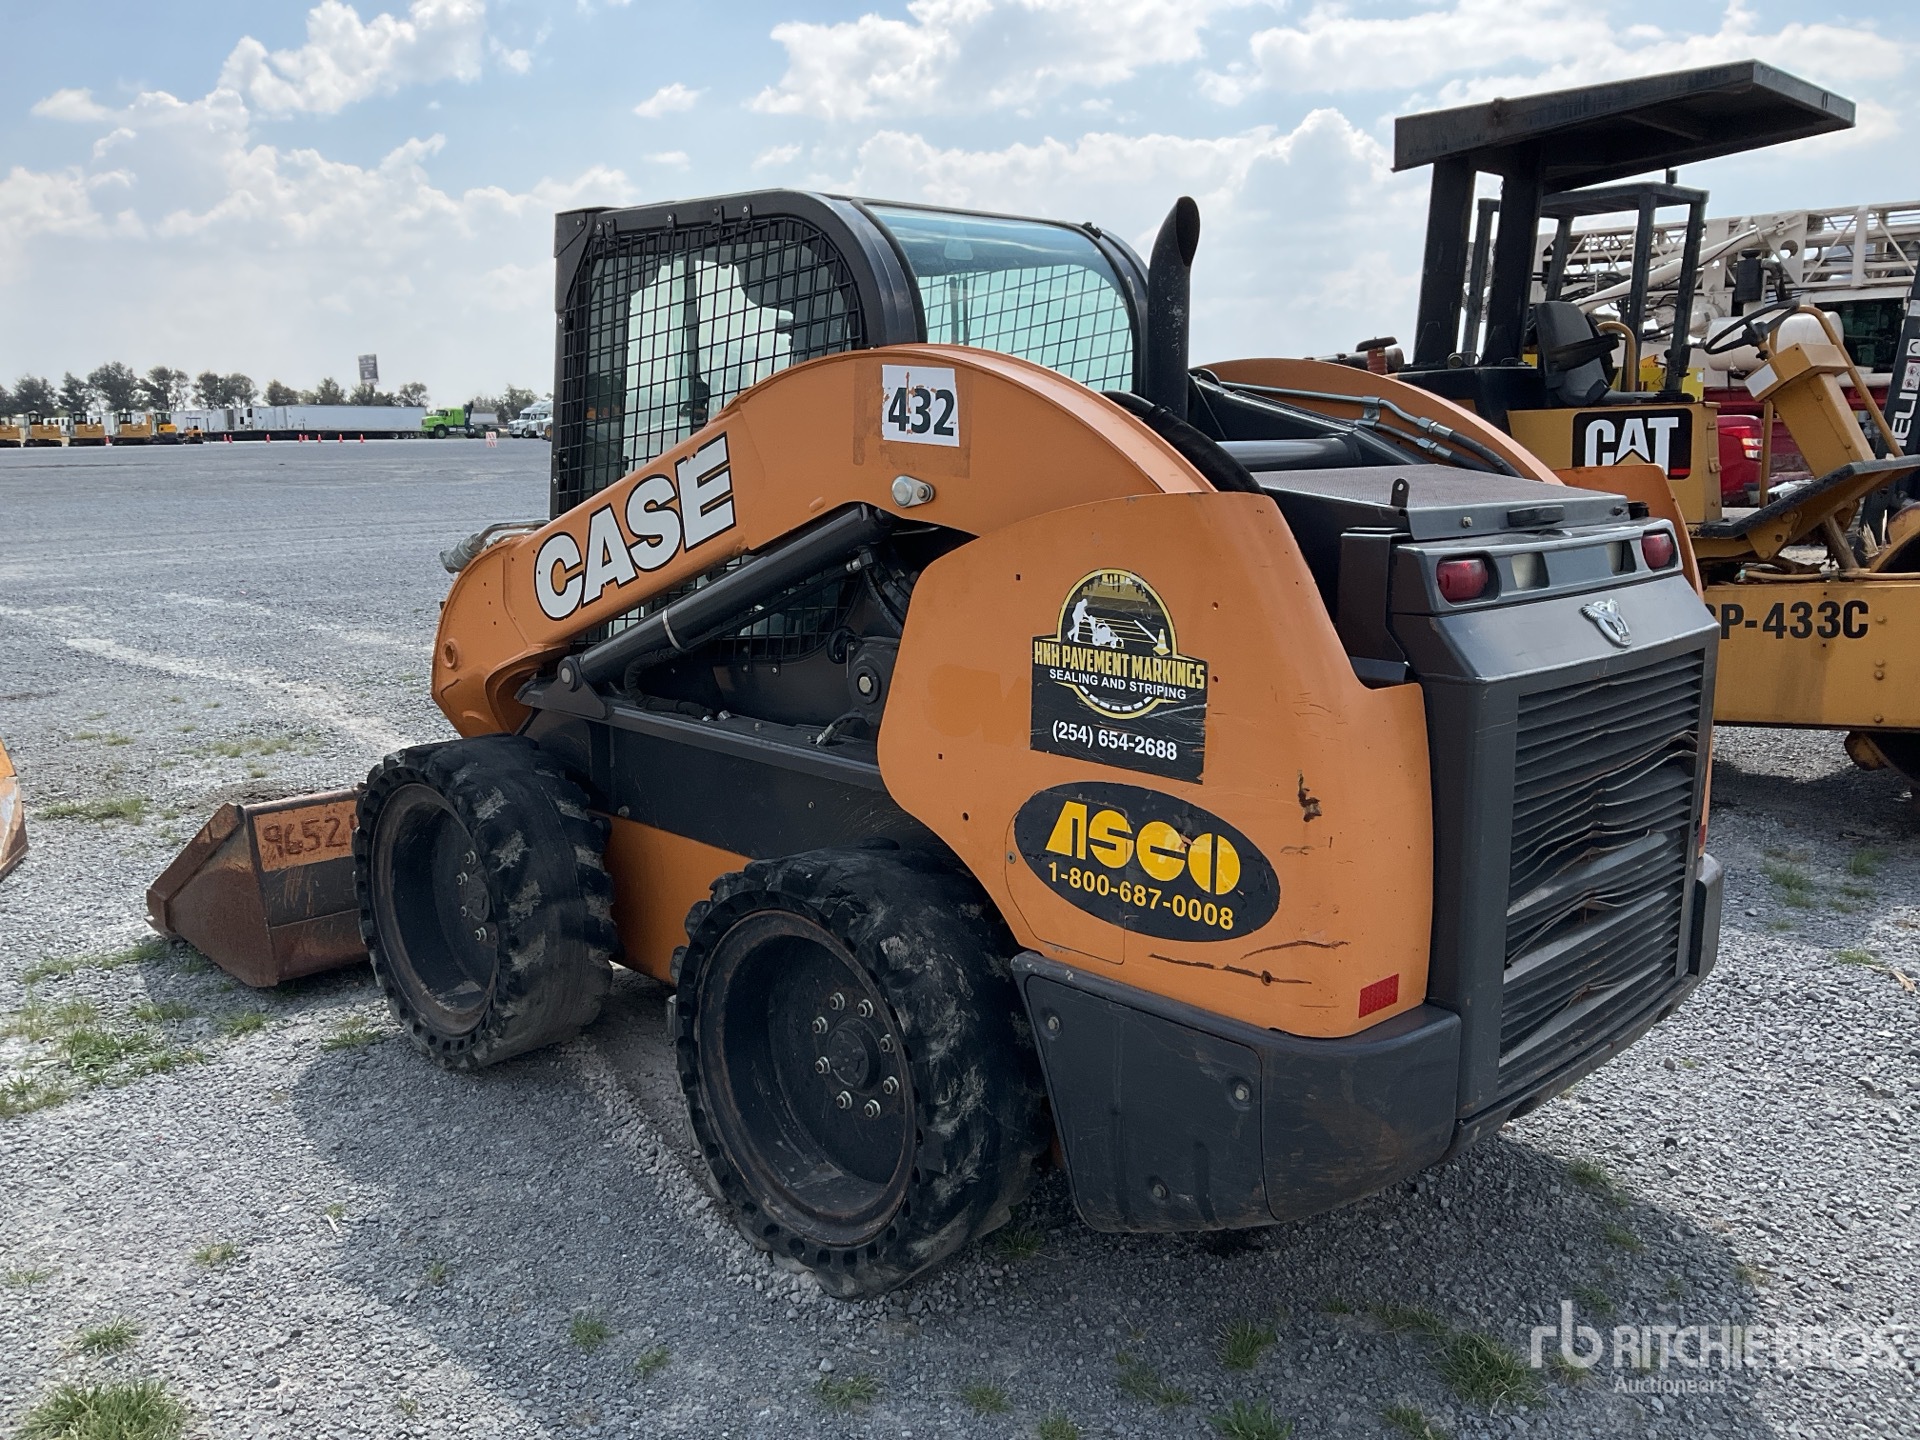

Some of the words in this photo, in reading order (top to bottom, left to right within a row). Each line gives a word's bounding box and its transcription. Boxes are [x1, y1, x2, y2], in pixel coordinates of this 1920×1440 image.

[888, 387, 955, 437] 432
[1584, 416, 1679, 475] CAT
[534, 431, 737, 621] CASE
[1706, 600, 1869, 640] P-433C
[1034, 641, 1060, 667] HNH
[1062, 645, 1130, 678] PAVEMENT
[1131, 657, 1206, 690] MARKINGS
[1049, 668, 1099, 686] SEALING
[1100, 676, 1127, 691] AND
[1129, 681, 1188, 700] STRIPING
[1052, 719, 1094, 748] (254)
[1098, 729, 1178, 761] 654-2688
[1045, 800, 1241, 895] ASCO
[1048, 861, 1235, 931] 1-800-687-0008
